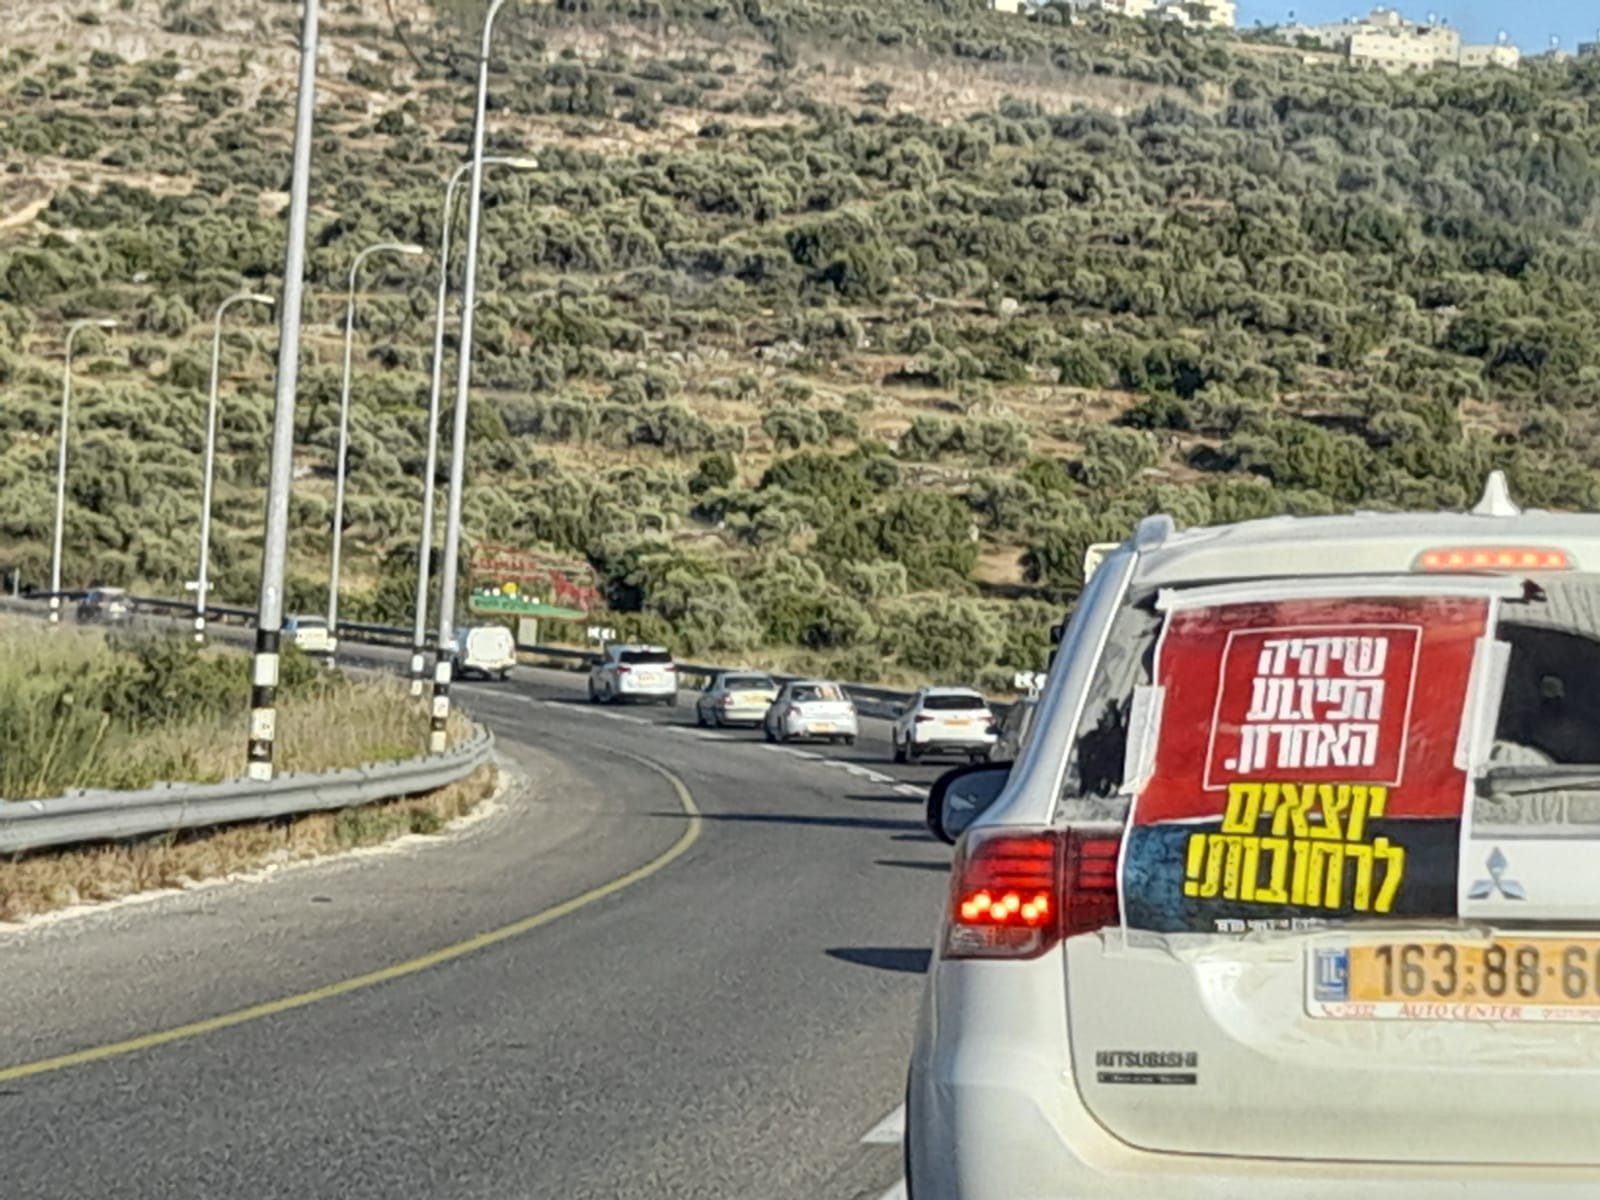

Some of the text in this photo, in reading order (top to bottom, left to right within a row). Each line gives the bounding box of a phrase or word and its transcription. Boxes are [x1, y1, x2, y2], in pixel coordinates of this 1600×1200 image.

[1258, 637, 1389, 677] שיהיה
[1246, 677, 1385, 722] הפיגוע
[1223, 722, 1380, 774] האחרון.
[1220, 783, 1388, 842] יוצאים
[1183, 834, 1405, 913] לרחובות!
[1399, 1003, 1523, 1020] AUTO CENTER
[1096, 1050, 1197, 1068] MITSUBISHI
